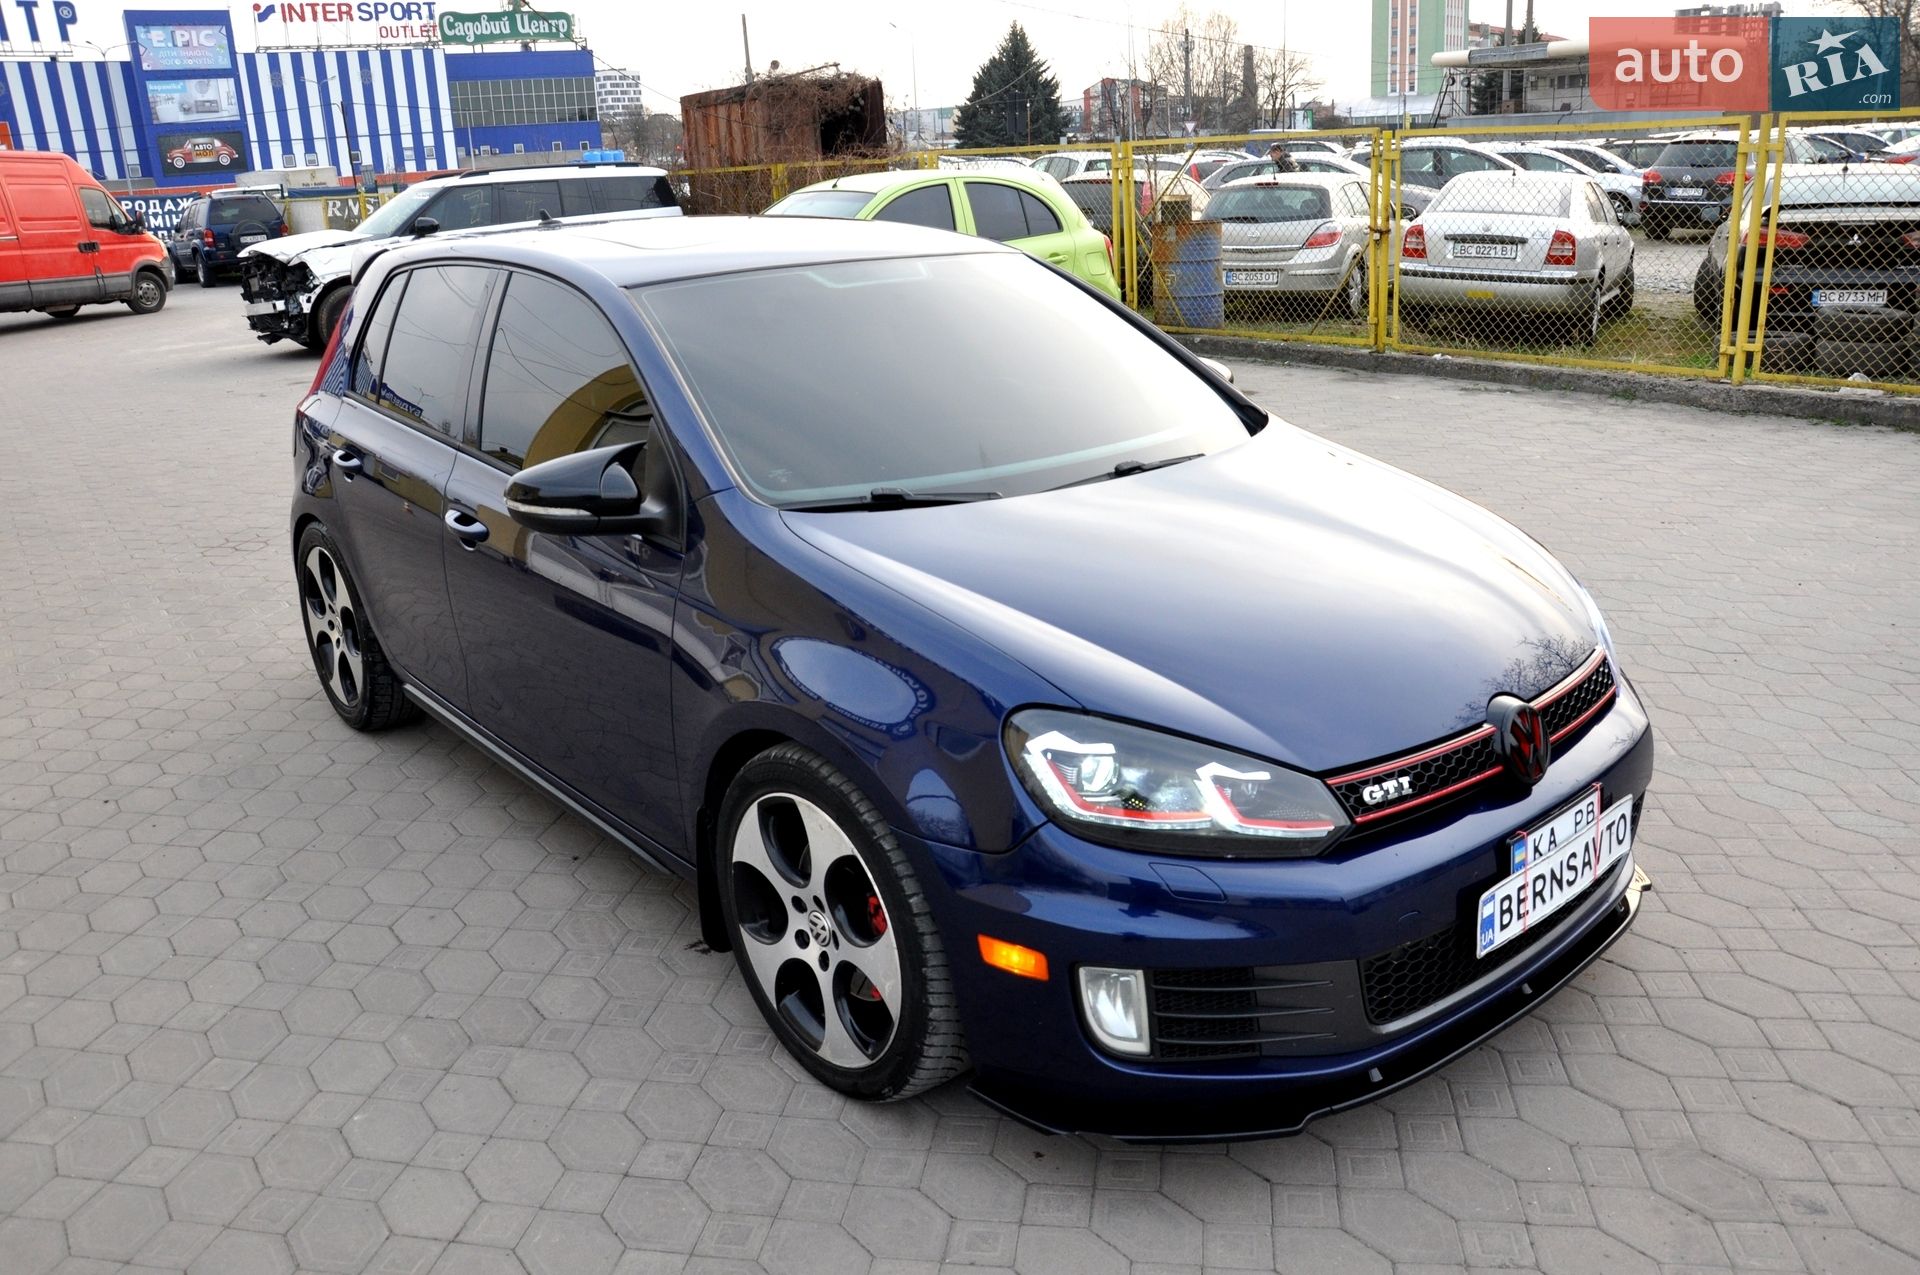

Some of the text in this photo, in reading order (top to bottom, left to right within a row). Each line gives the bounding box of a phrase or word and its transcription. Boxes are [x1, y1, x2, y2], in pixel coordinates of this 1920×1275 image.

[379, 25, 438, 38] OUTLET
[443, 13, 568, 42] Садовий Центр
[194, 143, 213, 151] АВТО
[1460, 246, 1472, 255] BC
[1475, 246, 1497, 256] 0221
[1820, 291, 1836, 302] BC
[1838, 291, 1865, 302] 8733
[1362, 776, 1413, 805] GTI
[1499, 812, 1628, 933] BERNSAVTO
[1481, 928, 1495, 946] UA
